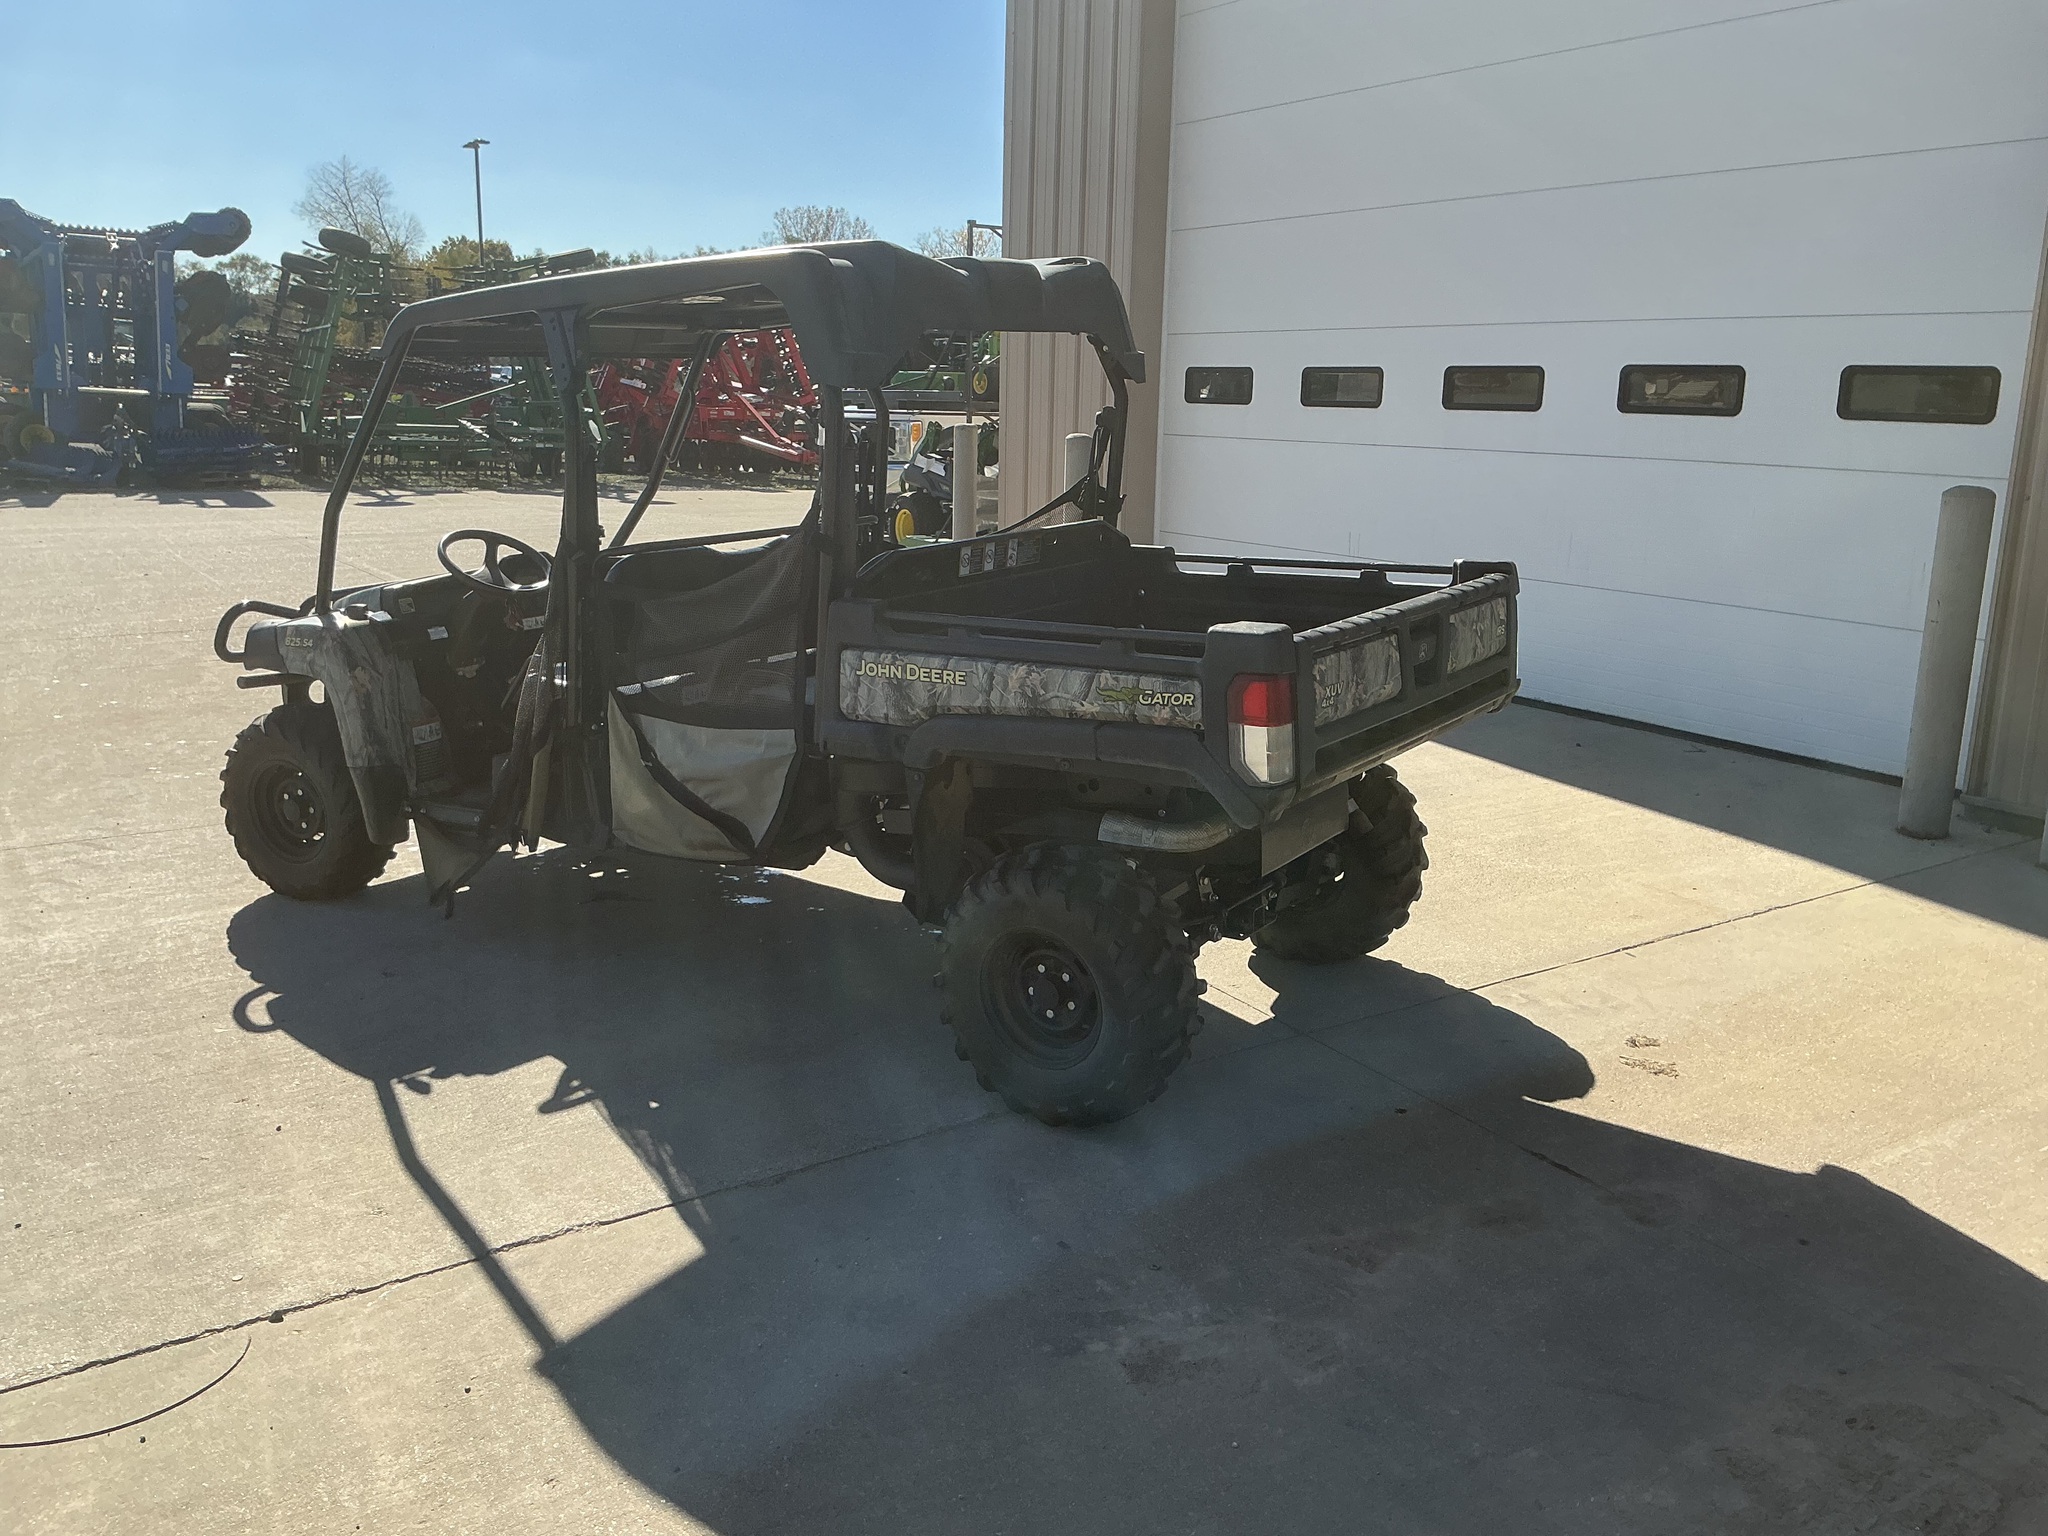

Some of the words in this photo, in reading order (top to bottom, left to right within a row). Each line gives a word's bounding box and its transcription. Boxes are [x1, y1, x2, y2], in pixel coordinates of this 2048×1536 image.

[303, 638, 313, 647] S4
[856, 660, 902, 678] JOHN
[906, 664, 966, 685] DEERE
[1325, 682, 1343, 697] XUV
[1139, 690, 1194, 705] GATOR
